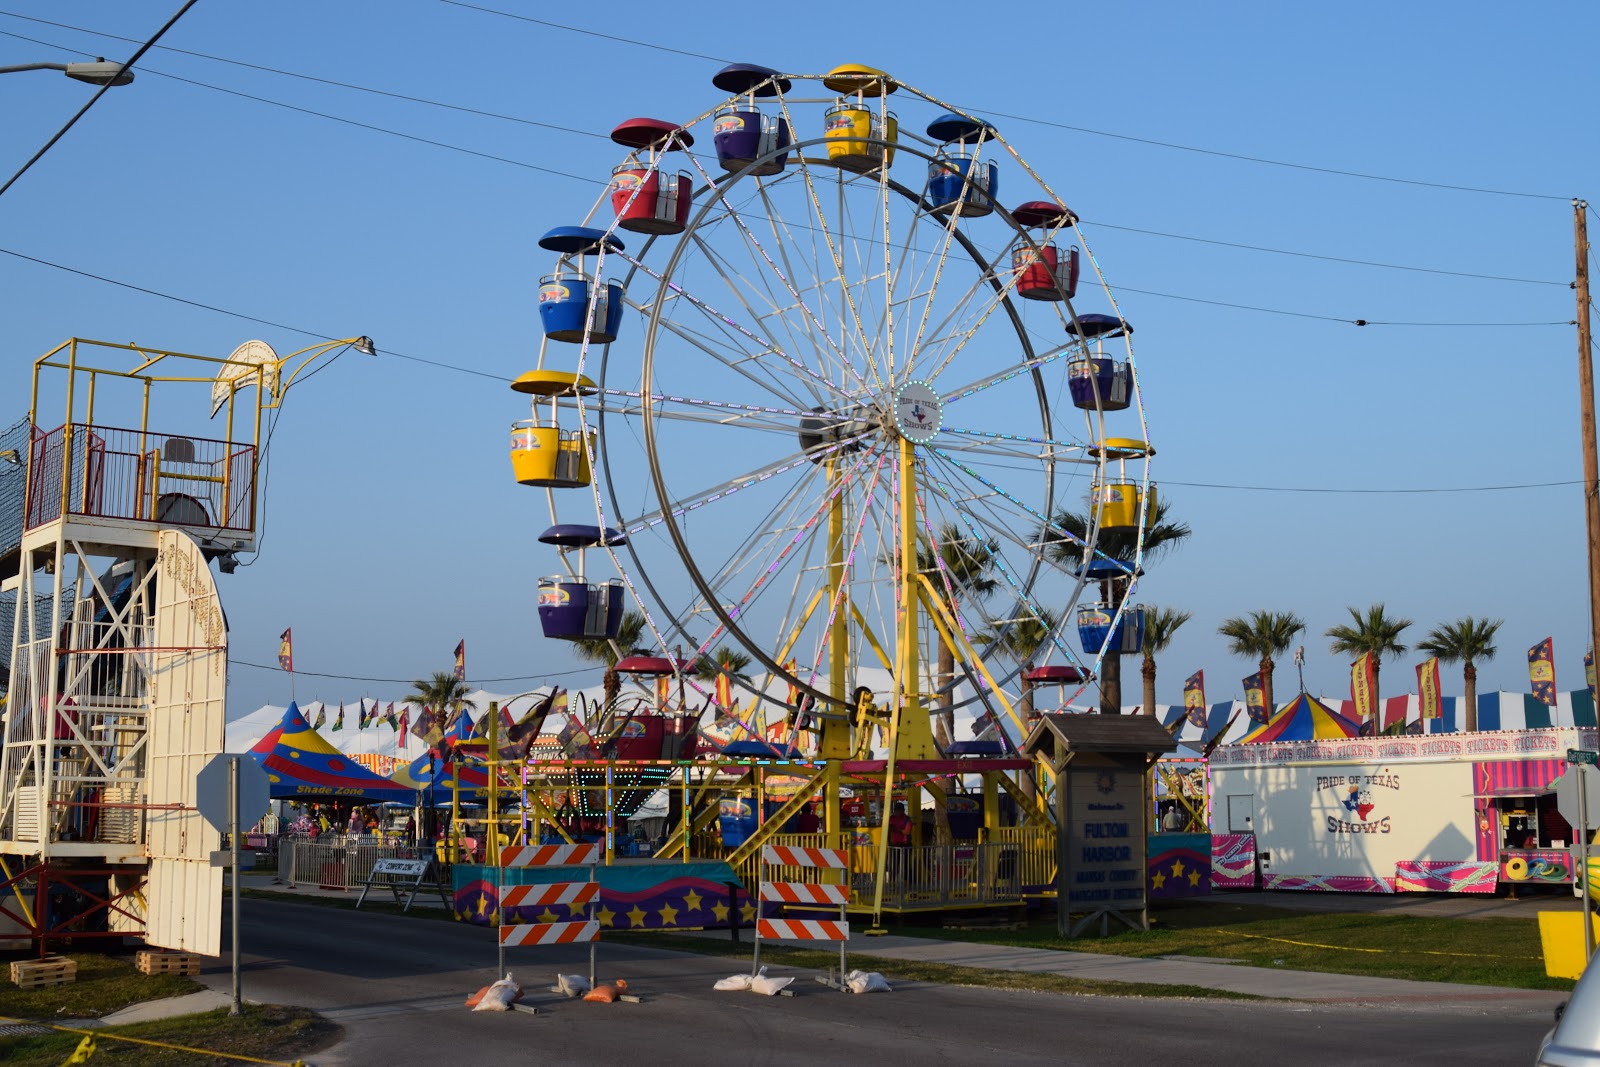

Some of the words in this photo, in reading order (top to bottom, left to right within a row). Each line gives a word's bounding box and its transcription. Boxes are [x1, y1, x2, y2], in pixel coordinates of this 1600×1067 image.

[922, 401, 937, 411] TEXAS
[904, 418, 933, 431] SHOWS
[1259, 748, 1293, 762] TICKETS
[1297, 746, 1333, 761] TICKETS
[1337, 744, 1374, 760] TICKETS
[1380, 742, 1417, 759] TICKETS
[1422, 740, 1461, 756] TICKETS
[1467, 738, 1509, 753] TICKETS
[1513, 735, 1557, 751] TICKETS
[957, 760, 973, 769] EXIT
[296, 785, 332, 794] Shade
[335, 786, 364, 795] Zone
[1317, 776, 1345, 792] PRIDE
[1348, 775, 1361, 785] OF
[1364, 774, 1400, 790] TEXAS
[1084, 822, 1128, 838] FULTON
[1327, 815, 1391, 834] SHOWS
[1082, 846, 1131, 862] HARBOR
